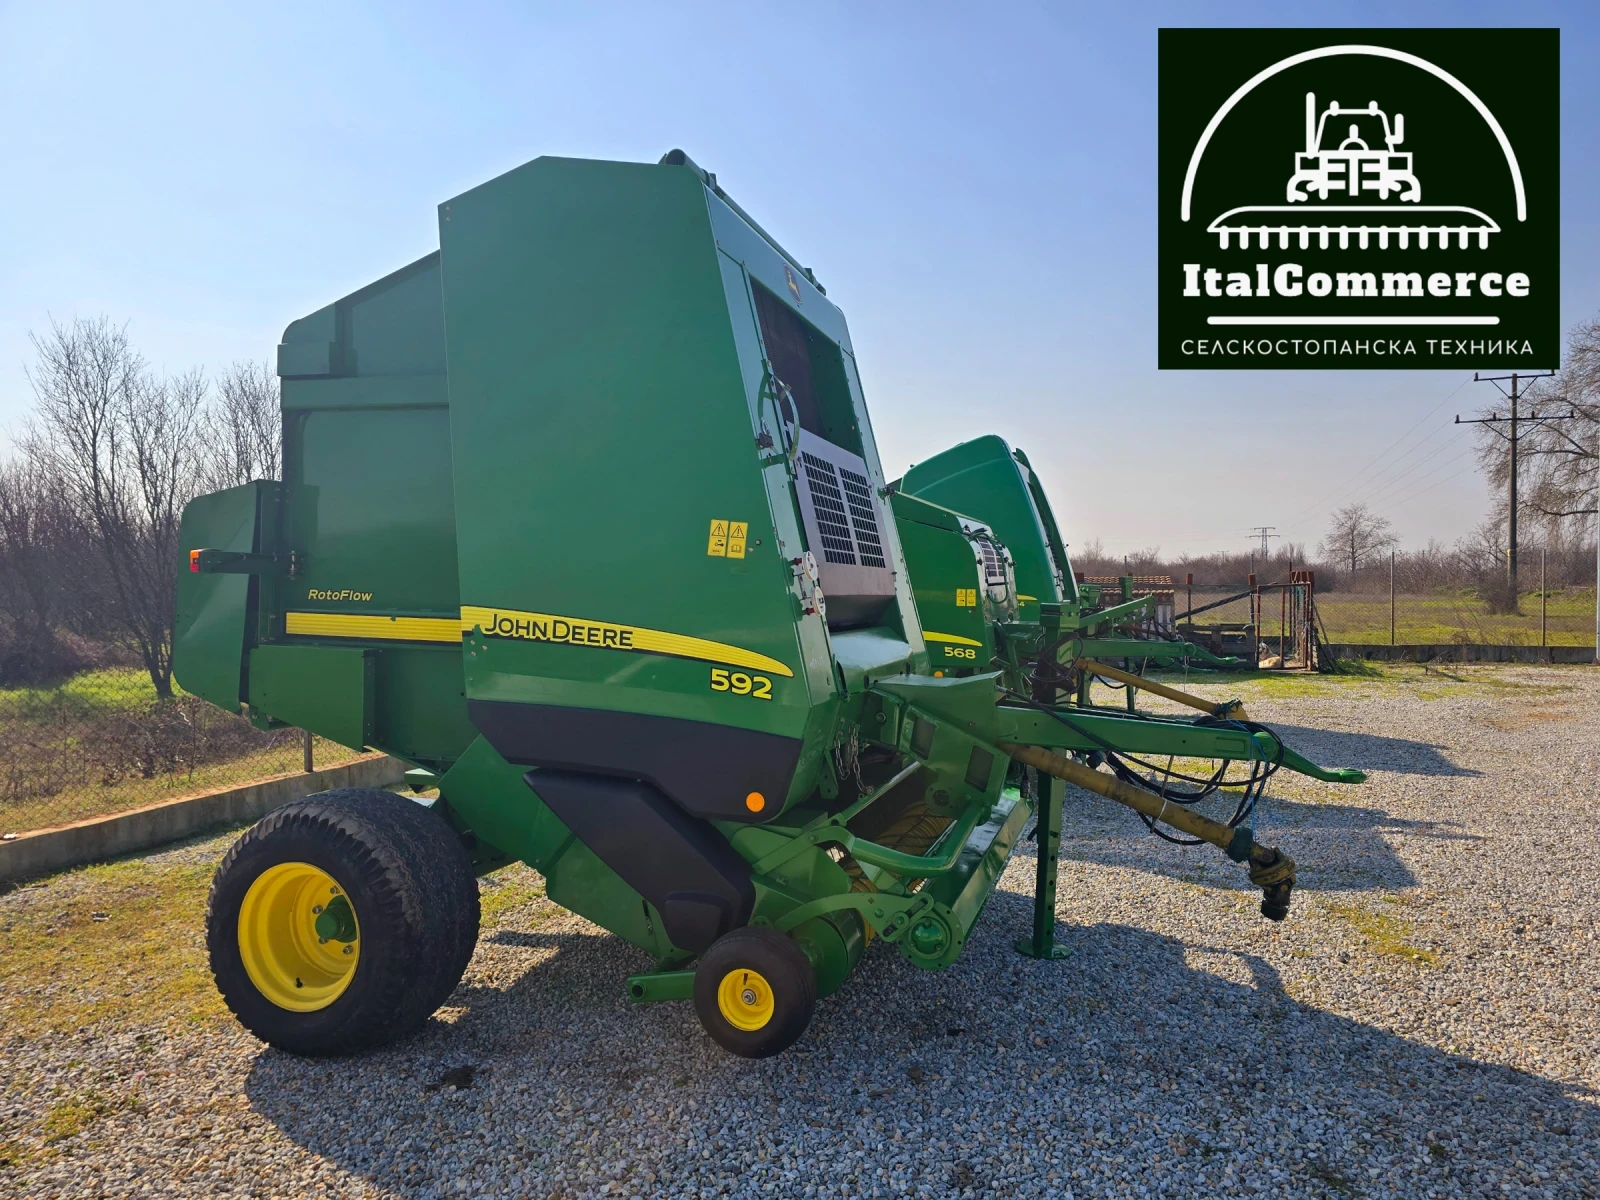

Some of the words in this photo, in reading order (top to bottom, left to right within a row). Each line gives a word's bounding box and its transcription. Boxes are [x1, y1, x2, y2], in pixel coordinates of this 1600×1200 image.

[308, 589, 373, 601] RotoFlow
[484, 613, 548, 638] JOHN
[552, 619, 633, 647] DEERE
[944, 646, 976, 659] 568
[710, 668, 773, 700] 592
